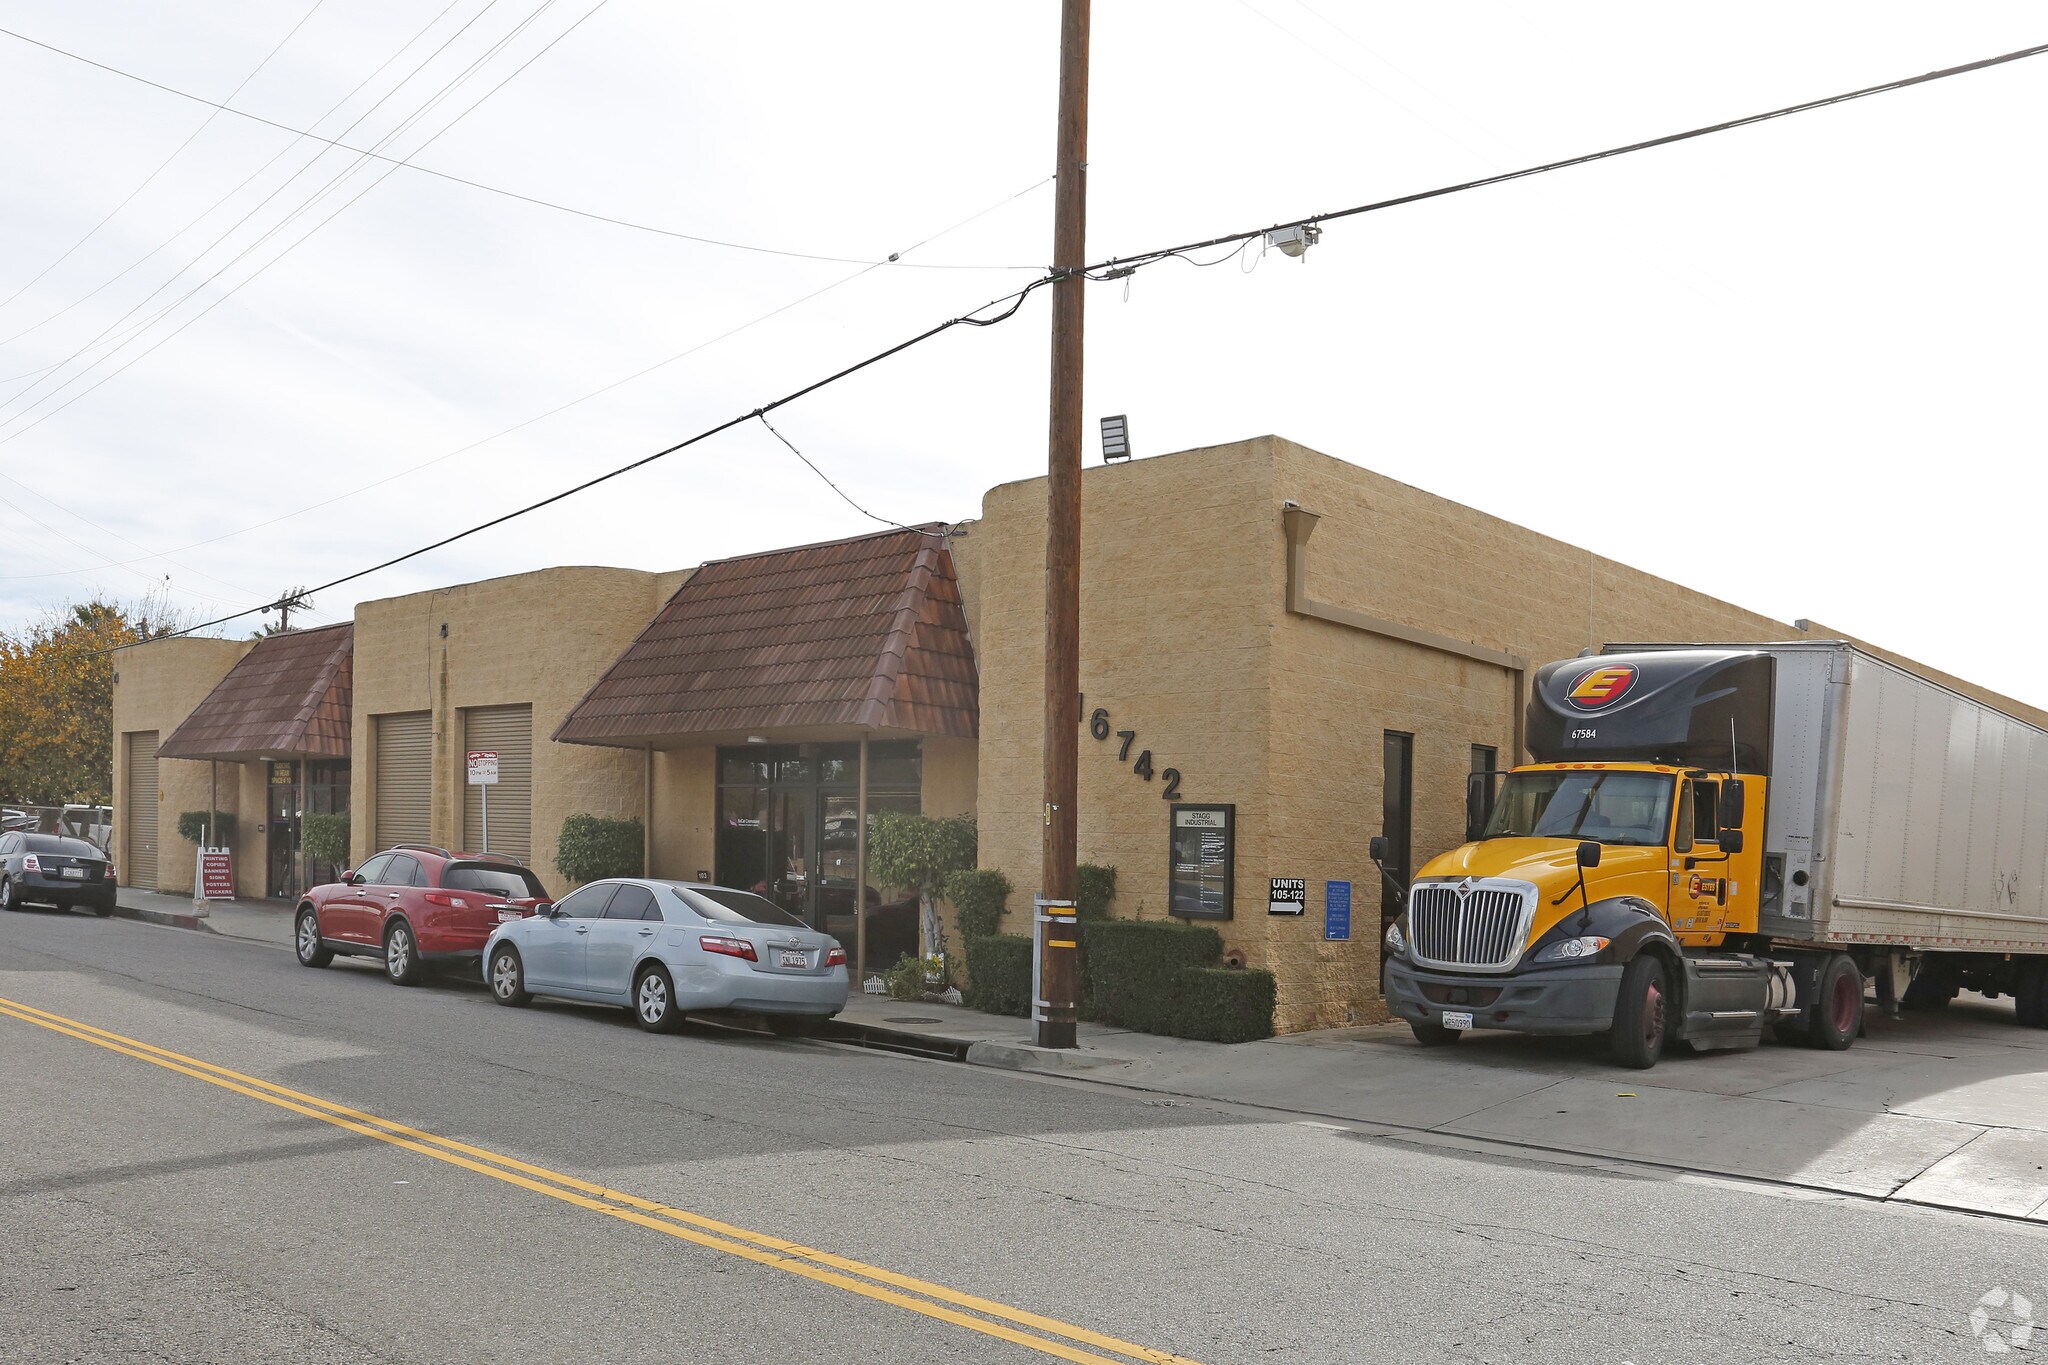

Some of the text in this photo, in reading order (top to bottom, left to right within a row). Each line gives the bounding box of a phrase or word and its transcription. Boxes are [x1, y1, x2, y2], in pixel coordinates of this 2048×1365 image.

[1571, 729, 1597, 739] 67584
[470, 760, 478, 768] NO
[1272, 879, 1304, 889] UNITS
[1702, 883, 1715, 891] ESTES
[1271, 889, 1304, 900] 105-122
